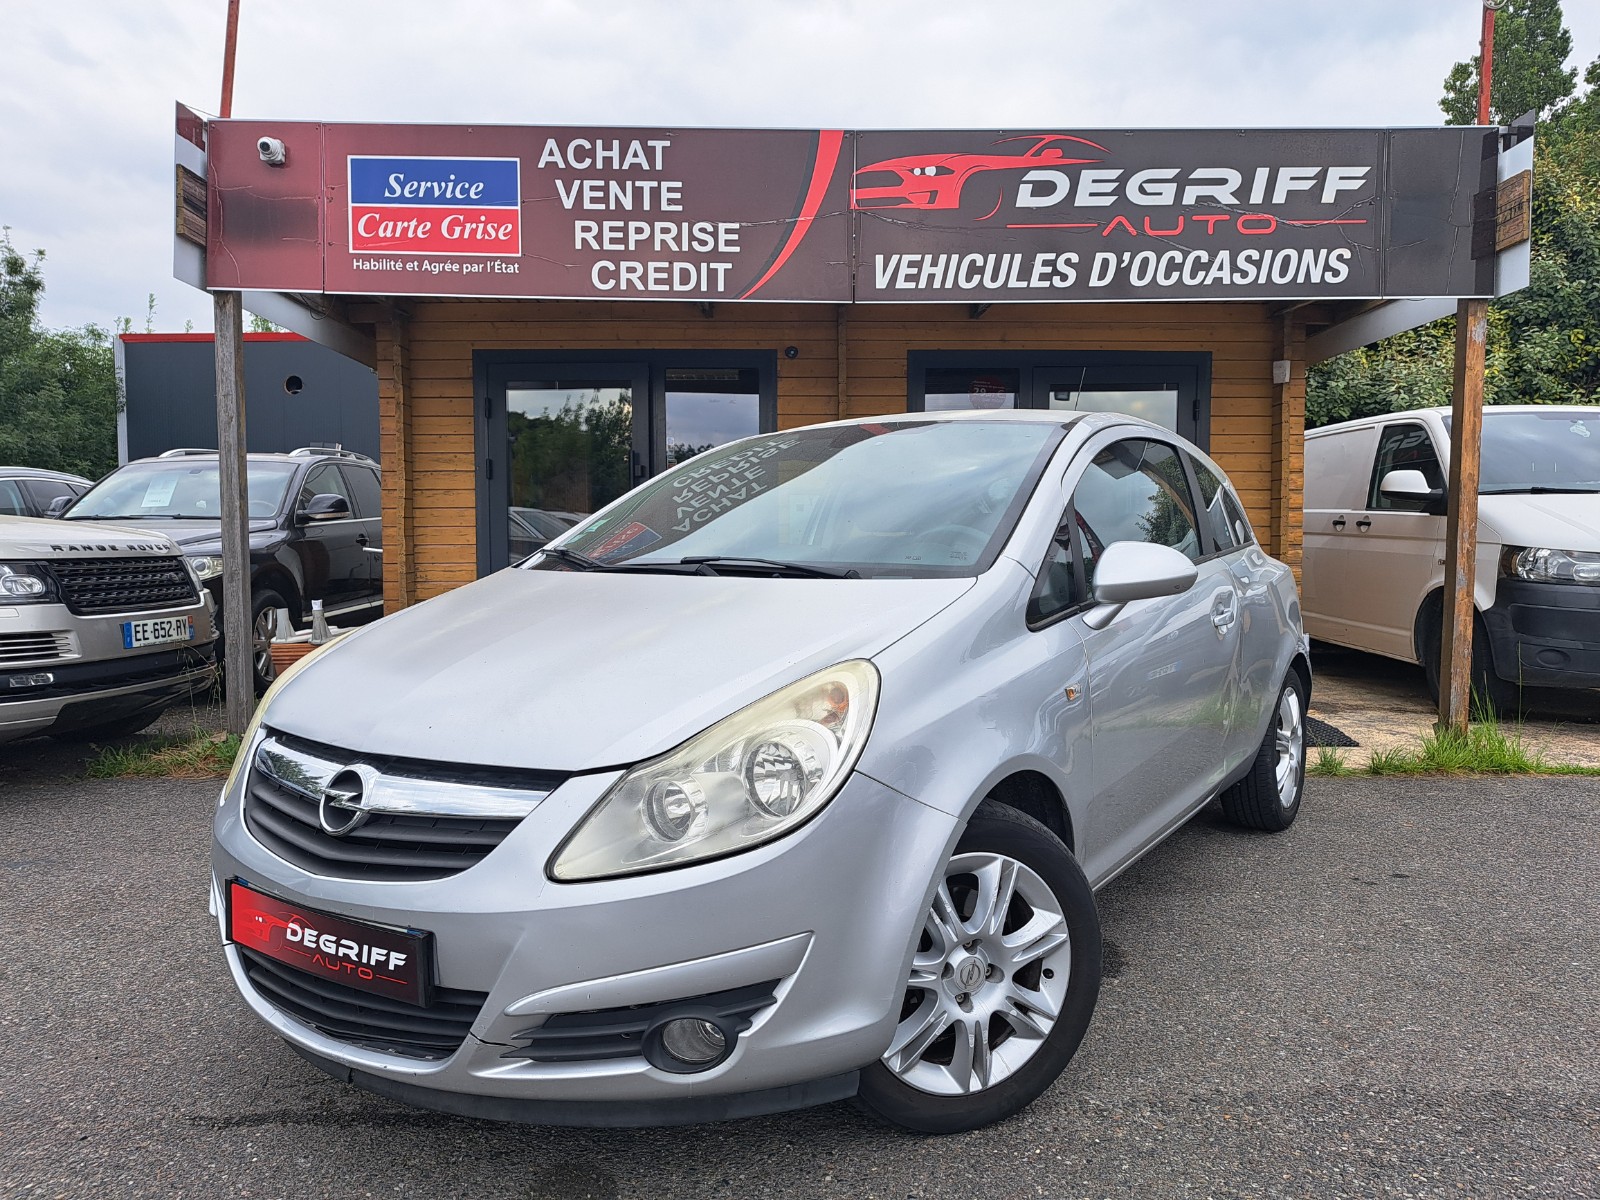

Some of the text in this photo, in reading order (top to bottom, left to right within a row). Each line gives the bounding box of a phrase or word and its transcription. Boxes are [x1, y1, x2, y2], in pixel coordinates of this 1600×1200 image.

[537, 138, 671, 171] ACHAT
[384, 173, 484, 199] Service
[555, 180, 683, 212] VENTE
[1015, 166, 1372, 208] DEGRIFF
[357, 213, 513, 241] Carte Grise
[574, 220, 741, 253] REPRISE
[1102, 214, 1277, 237] AUTO
[352, 257, 520, 275] Habilité et Agrée par l'État
[591, 260, 733, 292] CREDIT
[875, 247, 1352, 290] VEHICULES D'OCCASIONS
[50, 544, 171, 552] RANGE ROVER
[286, 922, 408, 971] DEGRIFF
[312, 954, 374, 980] AUTO
